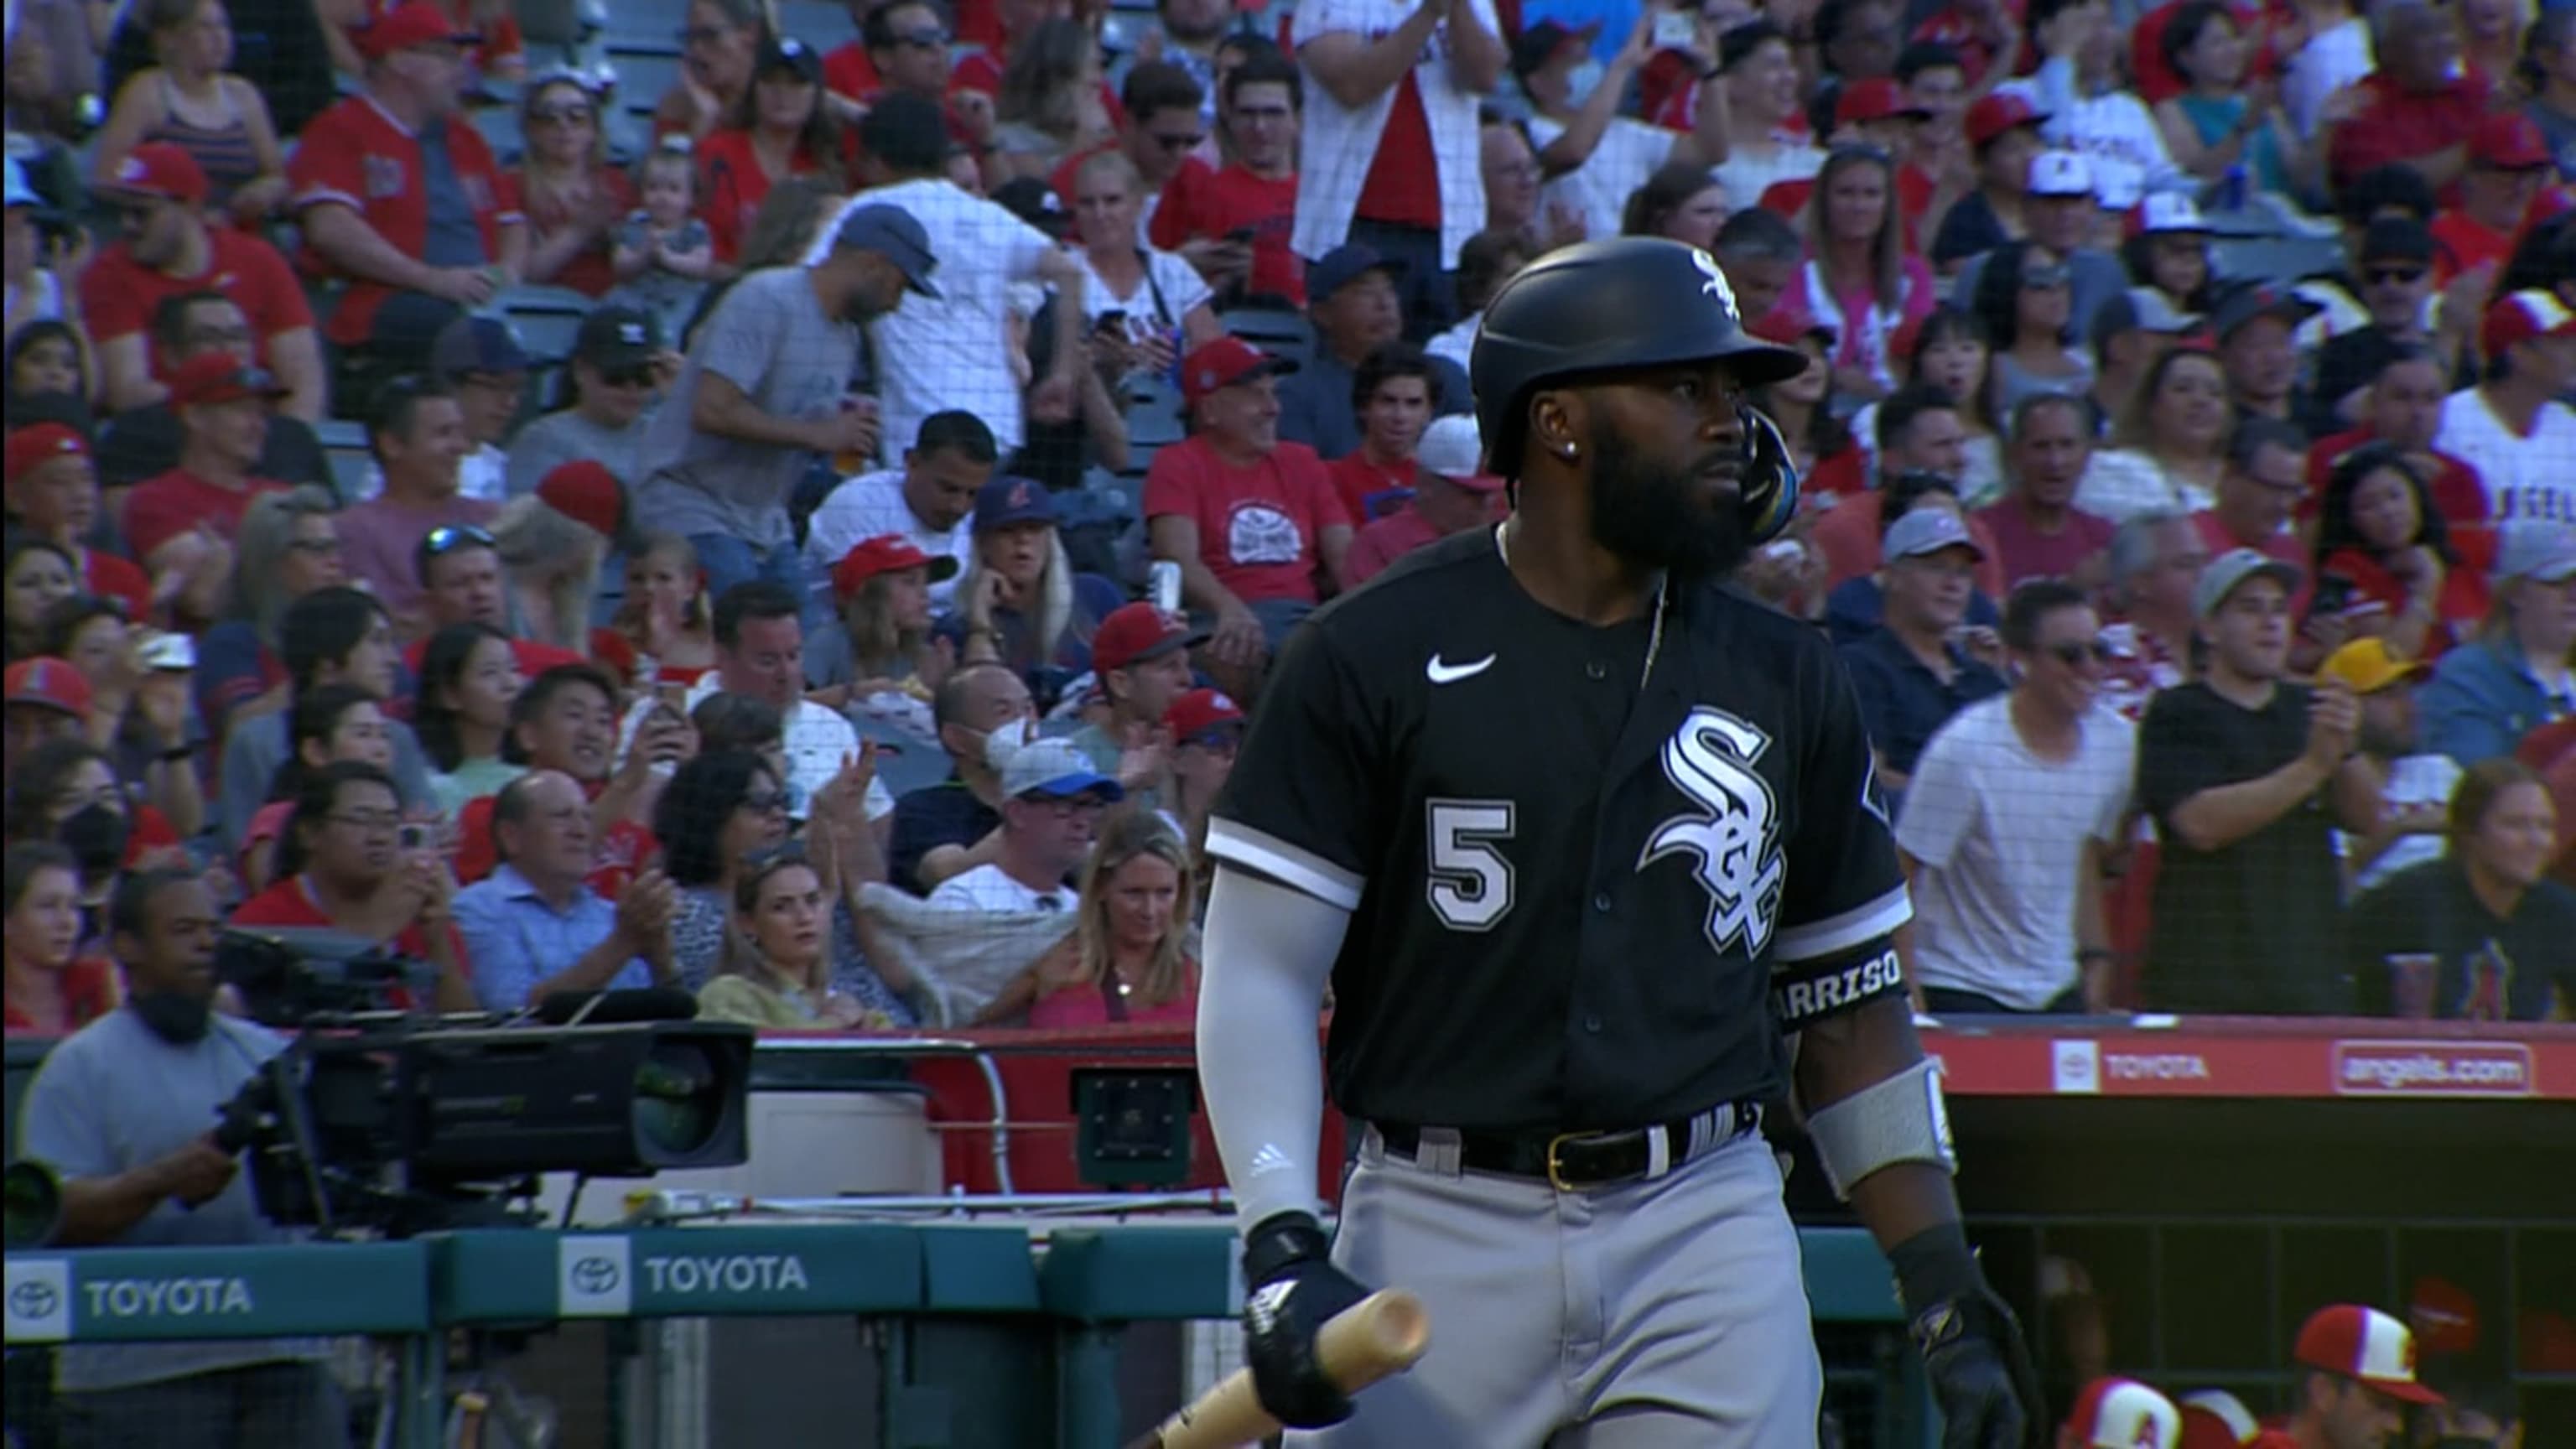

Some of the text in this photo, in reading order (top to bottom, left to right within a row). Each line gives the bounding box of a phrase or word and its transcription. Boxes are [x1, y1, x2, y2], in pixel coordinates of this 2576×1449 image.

[1426, 797, 1515, 932] 5
[2105, 1053, 2210, 1078] TOYOTA
[2341, 1053, 2523, 1088] angels.com
[644, 1254, 808, 1293] TOYOTA
[83, 1277, 253, 1317] TOYOTA
